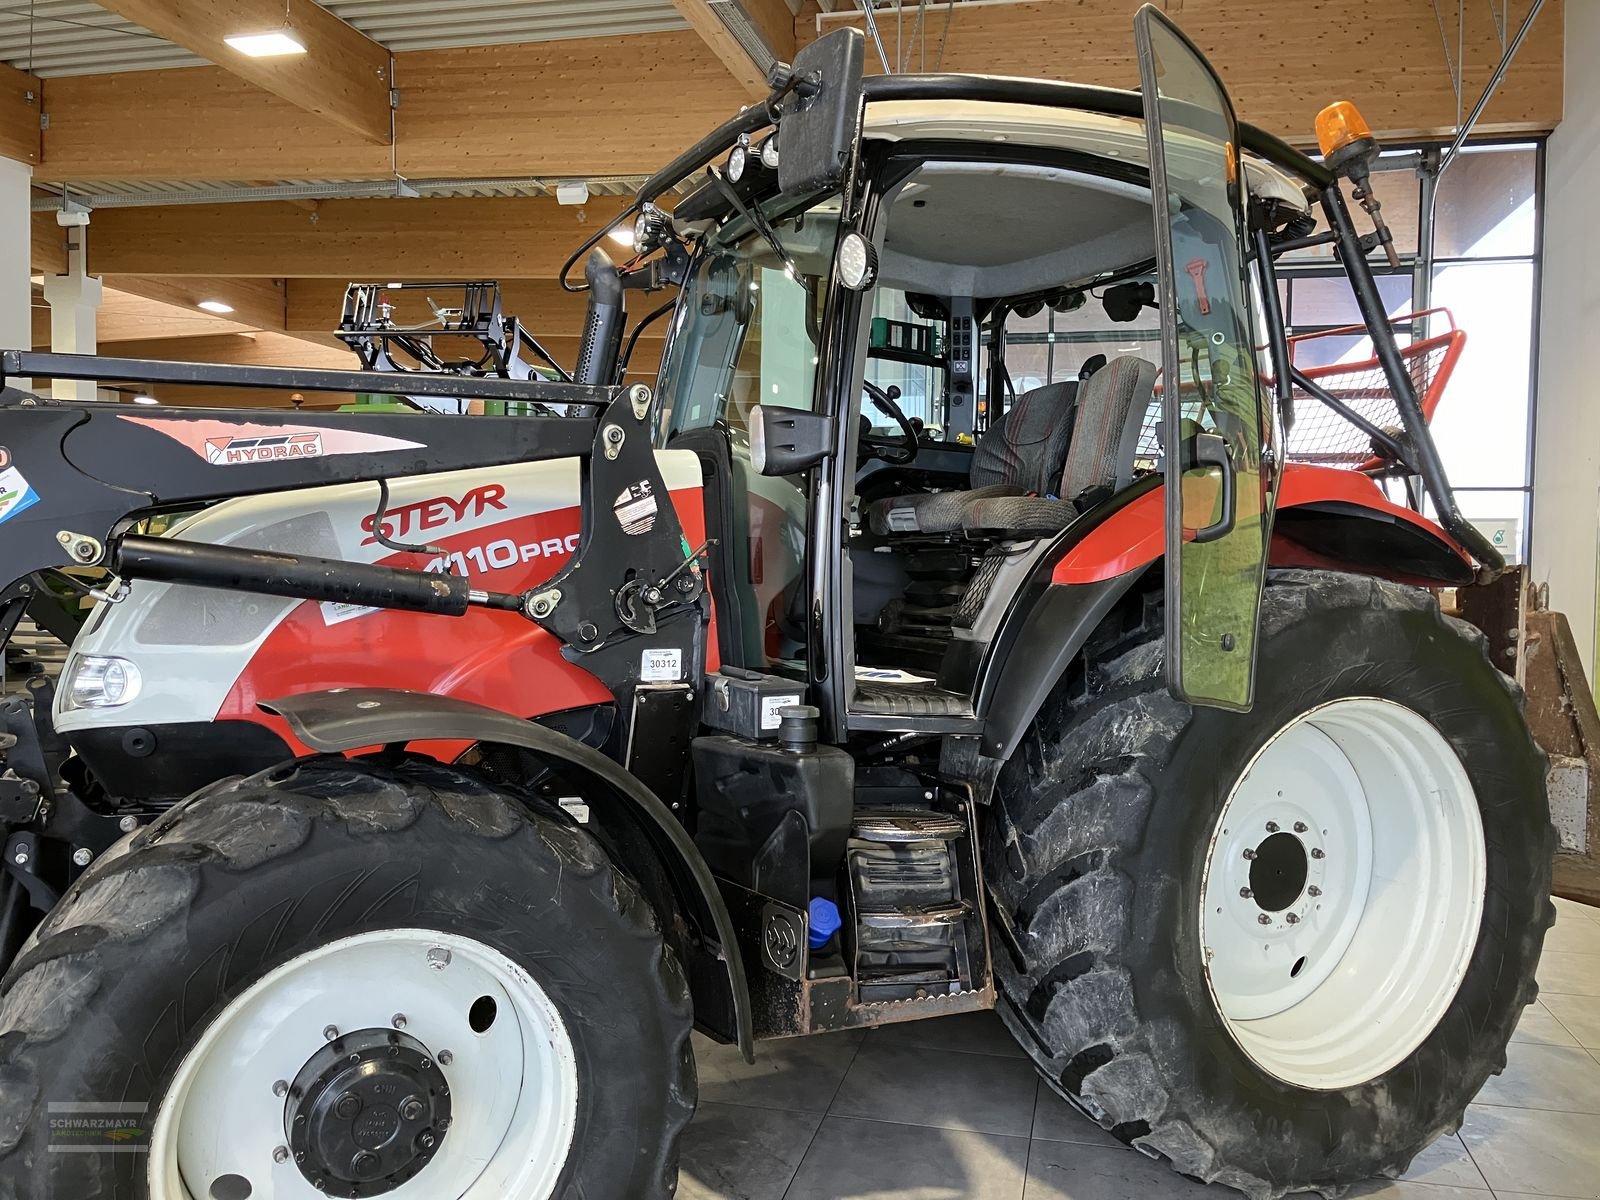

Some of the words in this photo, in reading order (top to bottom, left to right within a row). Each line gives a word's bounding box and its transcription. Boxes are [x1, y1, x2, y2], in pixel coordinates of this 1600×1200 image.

[227, 443, 317, 462] HYDRAC
[360, 484, 508, 546] STEYR
[650, 659, 677, 668] 30312
